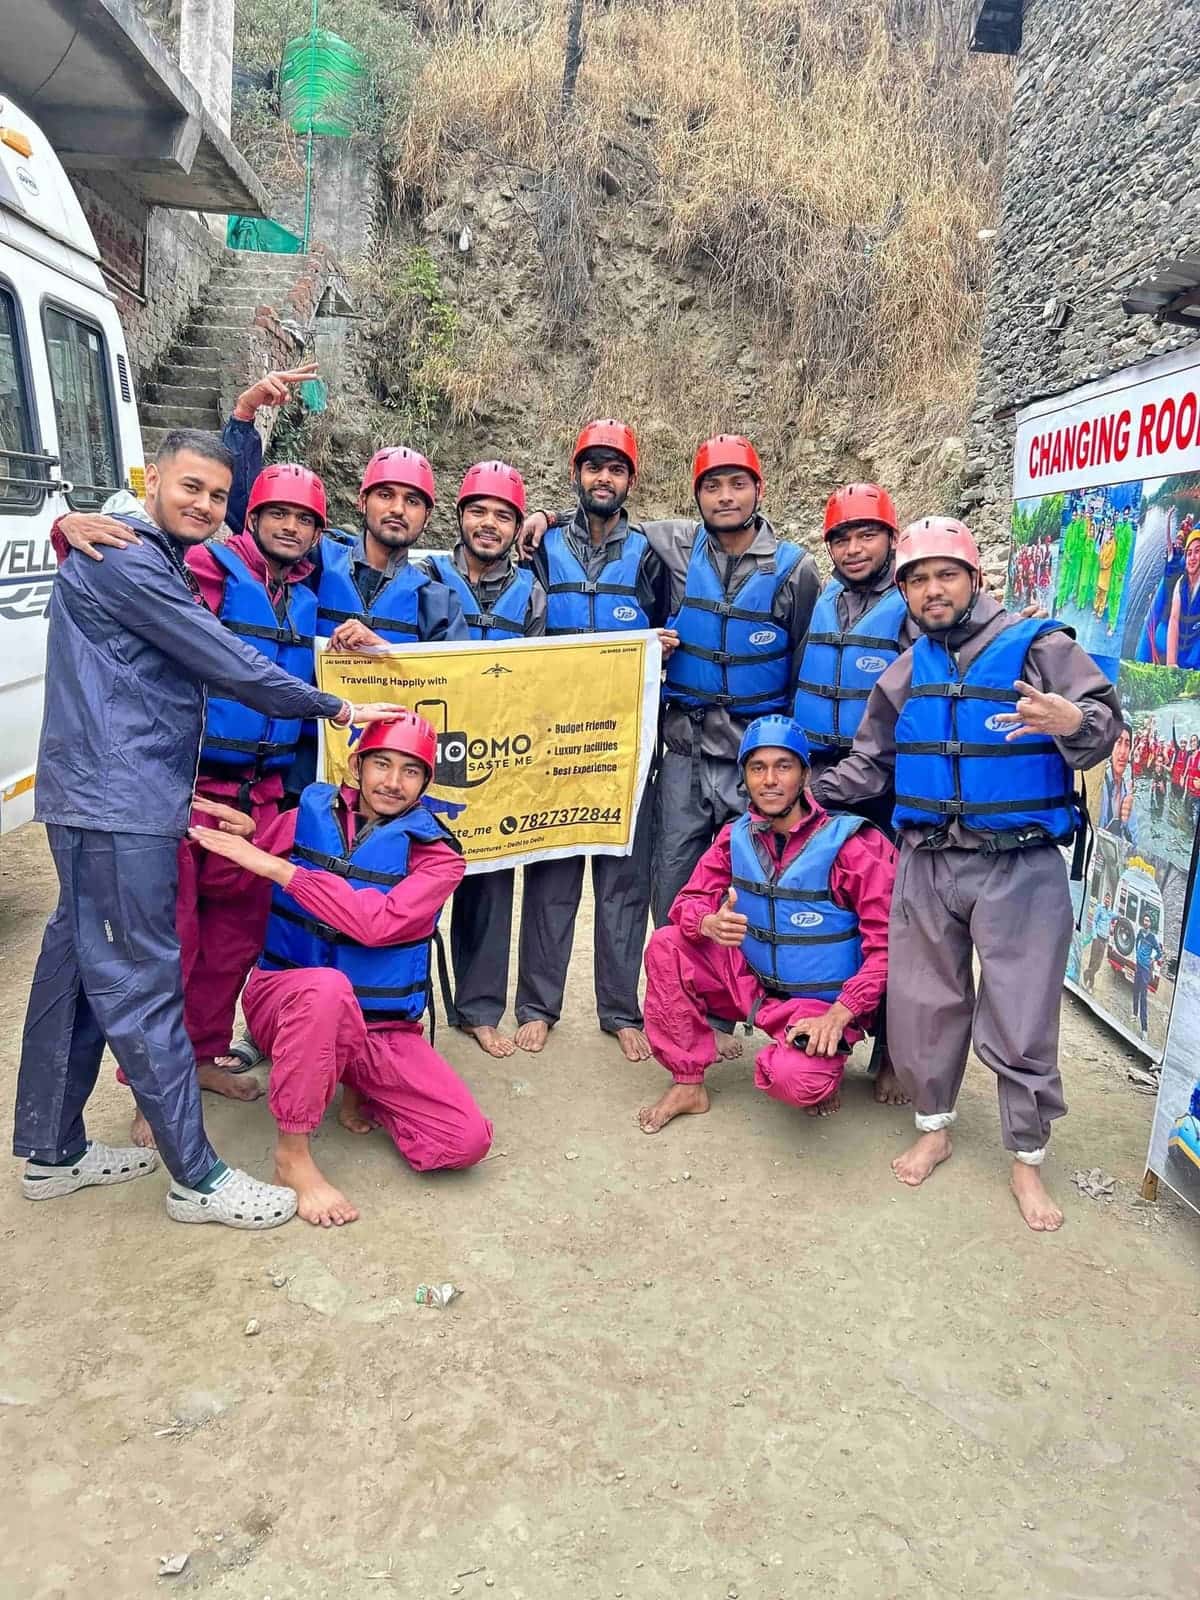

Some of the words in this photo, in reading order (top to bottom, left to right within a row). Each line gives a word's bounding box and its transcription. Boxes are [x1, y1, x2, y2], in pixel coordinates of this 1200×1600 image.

[1029, 409, 1131, 479] CHANGING
[1136, 391, 1200, 458] ROO
[0, 539, 59, 574] VELL
[340, 675, 388, 686] Travelling
[390, 677, 426, 688] Happily
[427, 676, 448, 685] with
[555, 722, 584, 734] Budget
[585, 720, 617, 731] Friendly
[554, 745, 582, 756] Luxury
[583, 741, 618, 753] facilities
[514, 756, 533, 767] ME
[553, 766, 571, 776] Best
[572, 762, 617, 775] Experience
[519, 807, 622, 831] 7827372844
[453, 826, 492, 839] te_me
[467, 845, 502, 855] Departures
[507, 839, 522, 848] Delhi
[530, 836, 545, 844] Delhi
